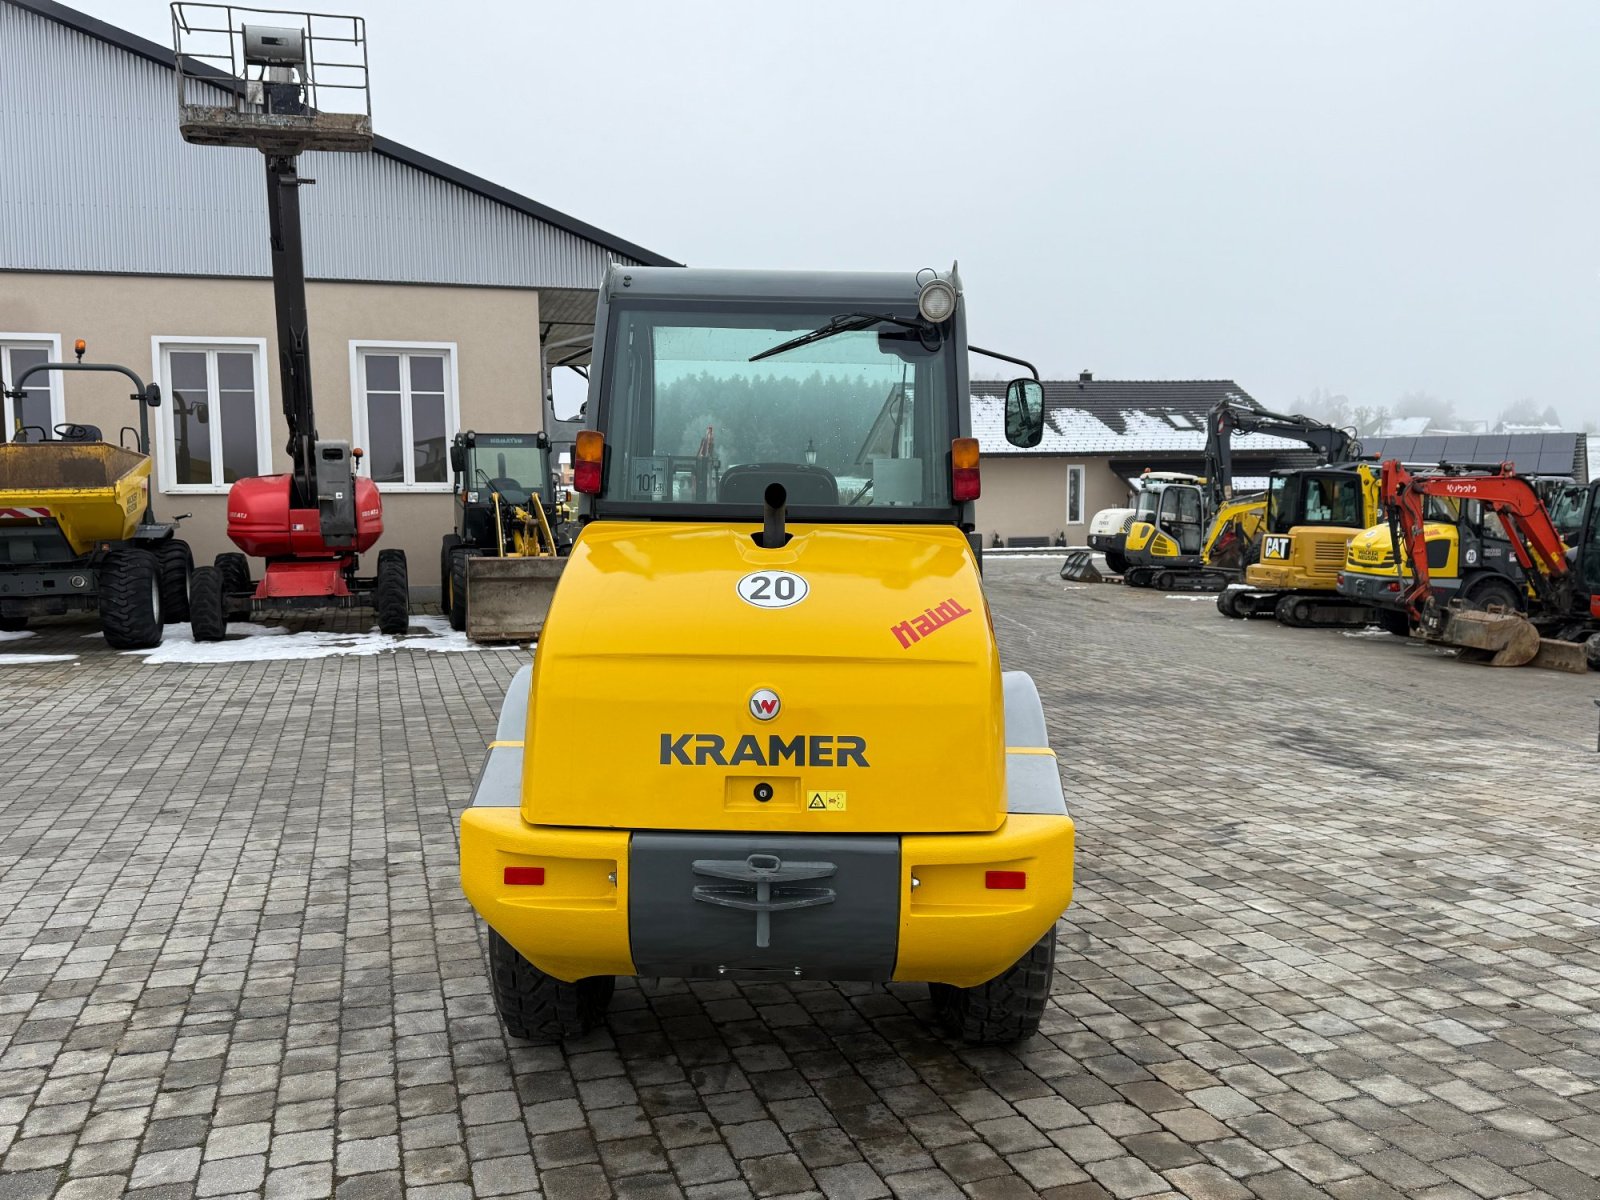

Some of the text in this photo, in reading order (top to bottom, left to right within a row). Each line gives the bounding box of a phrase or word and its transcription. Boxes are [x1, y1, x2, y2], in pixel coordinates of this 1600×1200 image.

[636, 474, 656, 492] 101
[1446, 484, 1477, 493] Kubota
[1265, 537, 1289, 559] CAT
[1467, 551, 1476, 562] 20
[750, 576, 795, 600] 20
[660, 733, 870, 767] KRAMER
